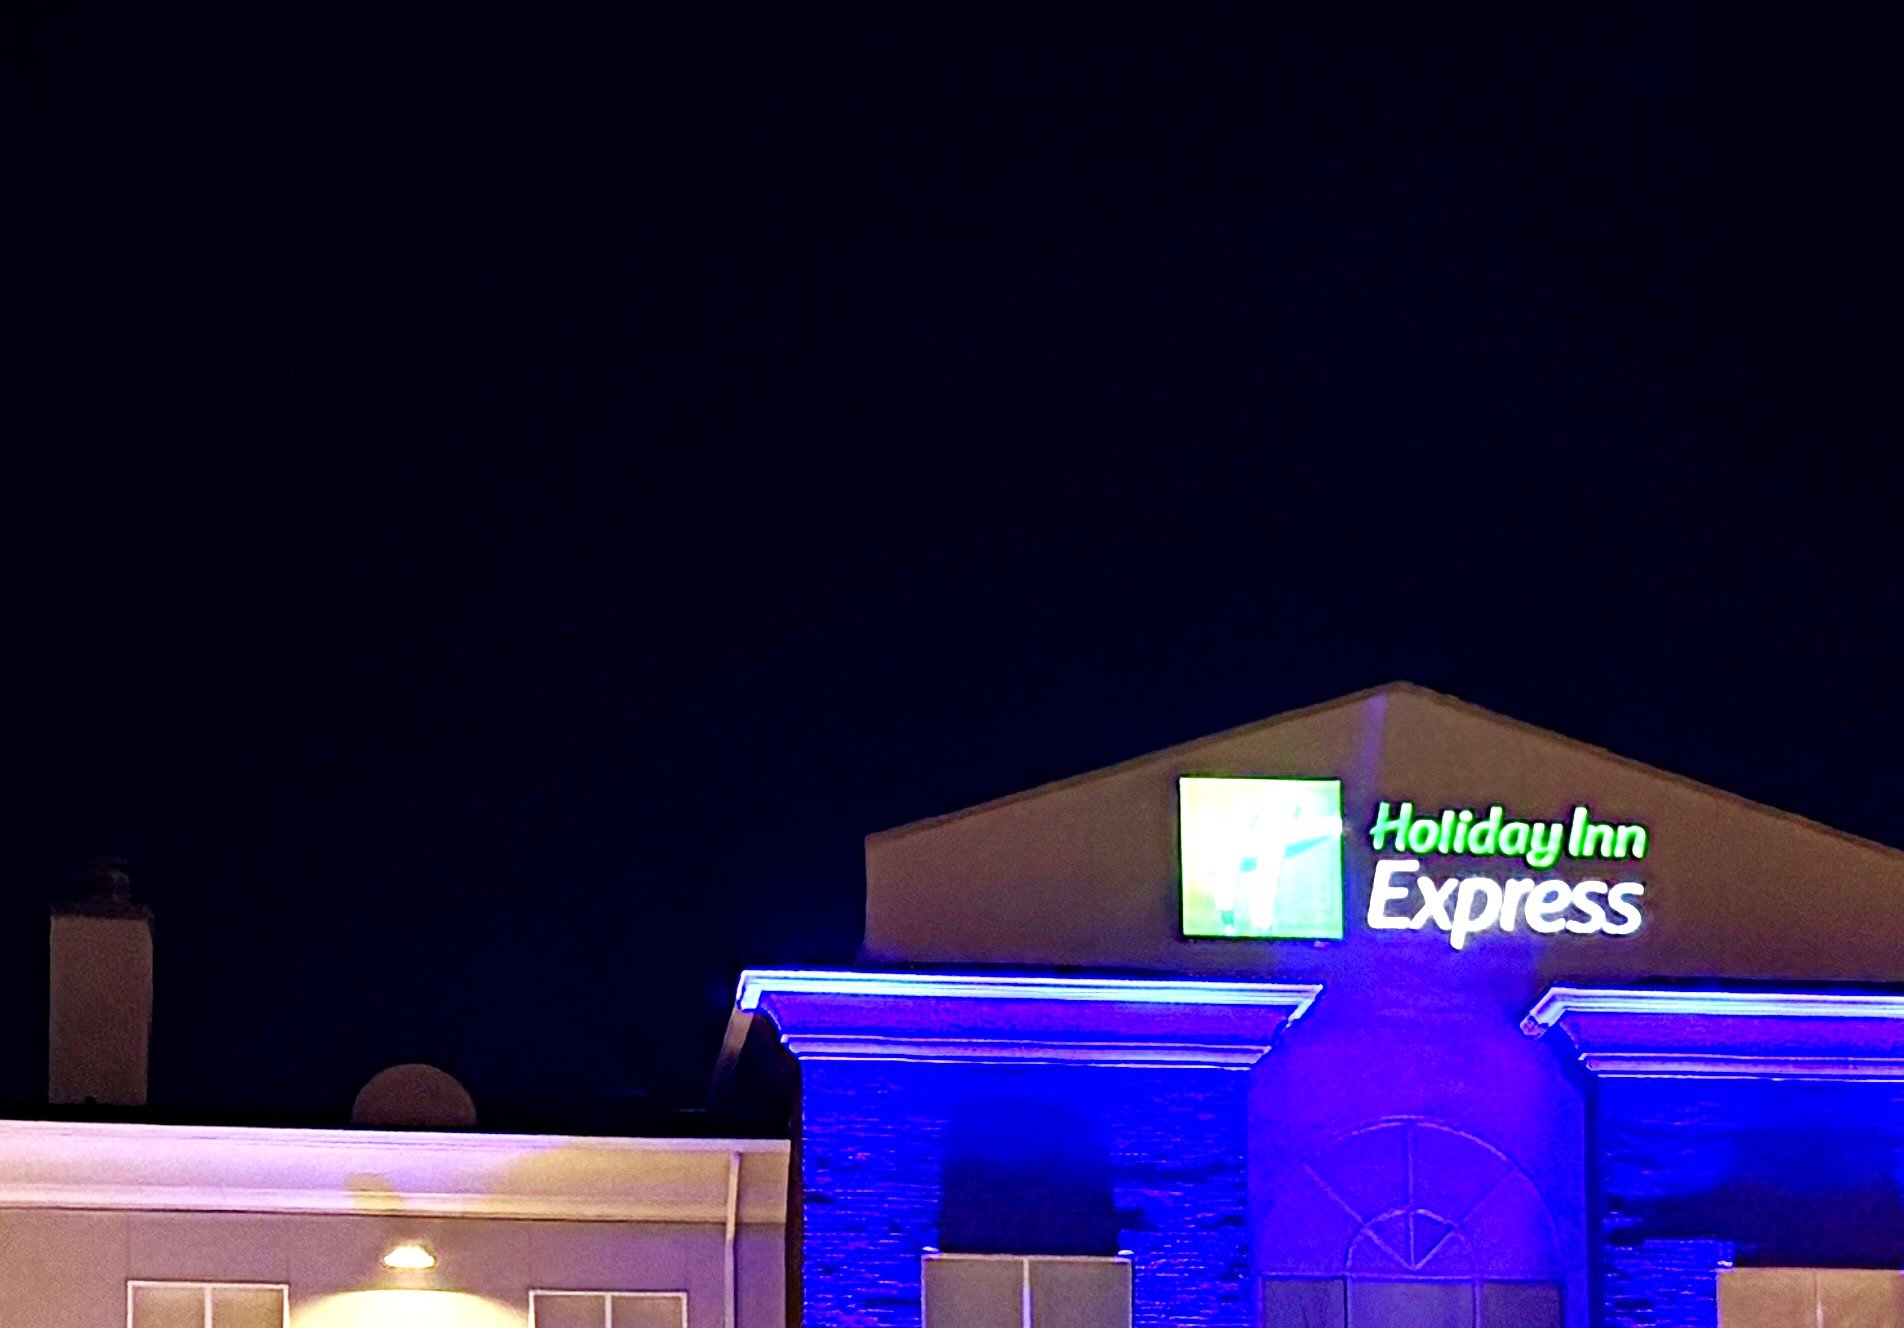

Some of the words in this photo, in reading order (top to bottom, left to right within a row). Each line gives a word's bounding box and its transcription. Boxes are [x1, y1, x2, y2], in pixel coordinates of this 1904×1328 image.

[1369, 801, 1564, 868] Holiday
[1568, 805, 1647, 859] Inn
[1366, 859, 1645, 950] Express
